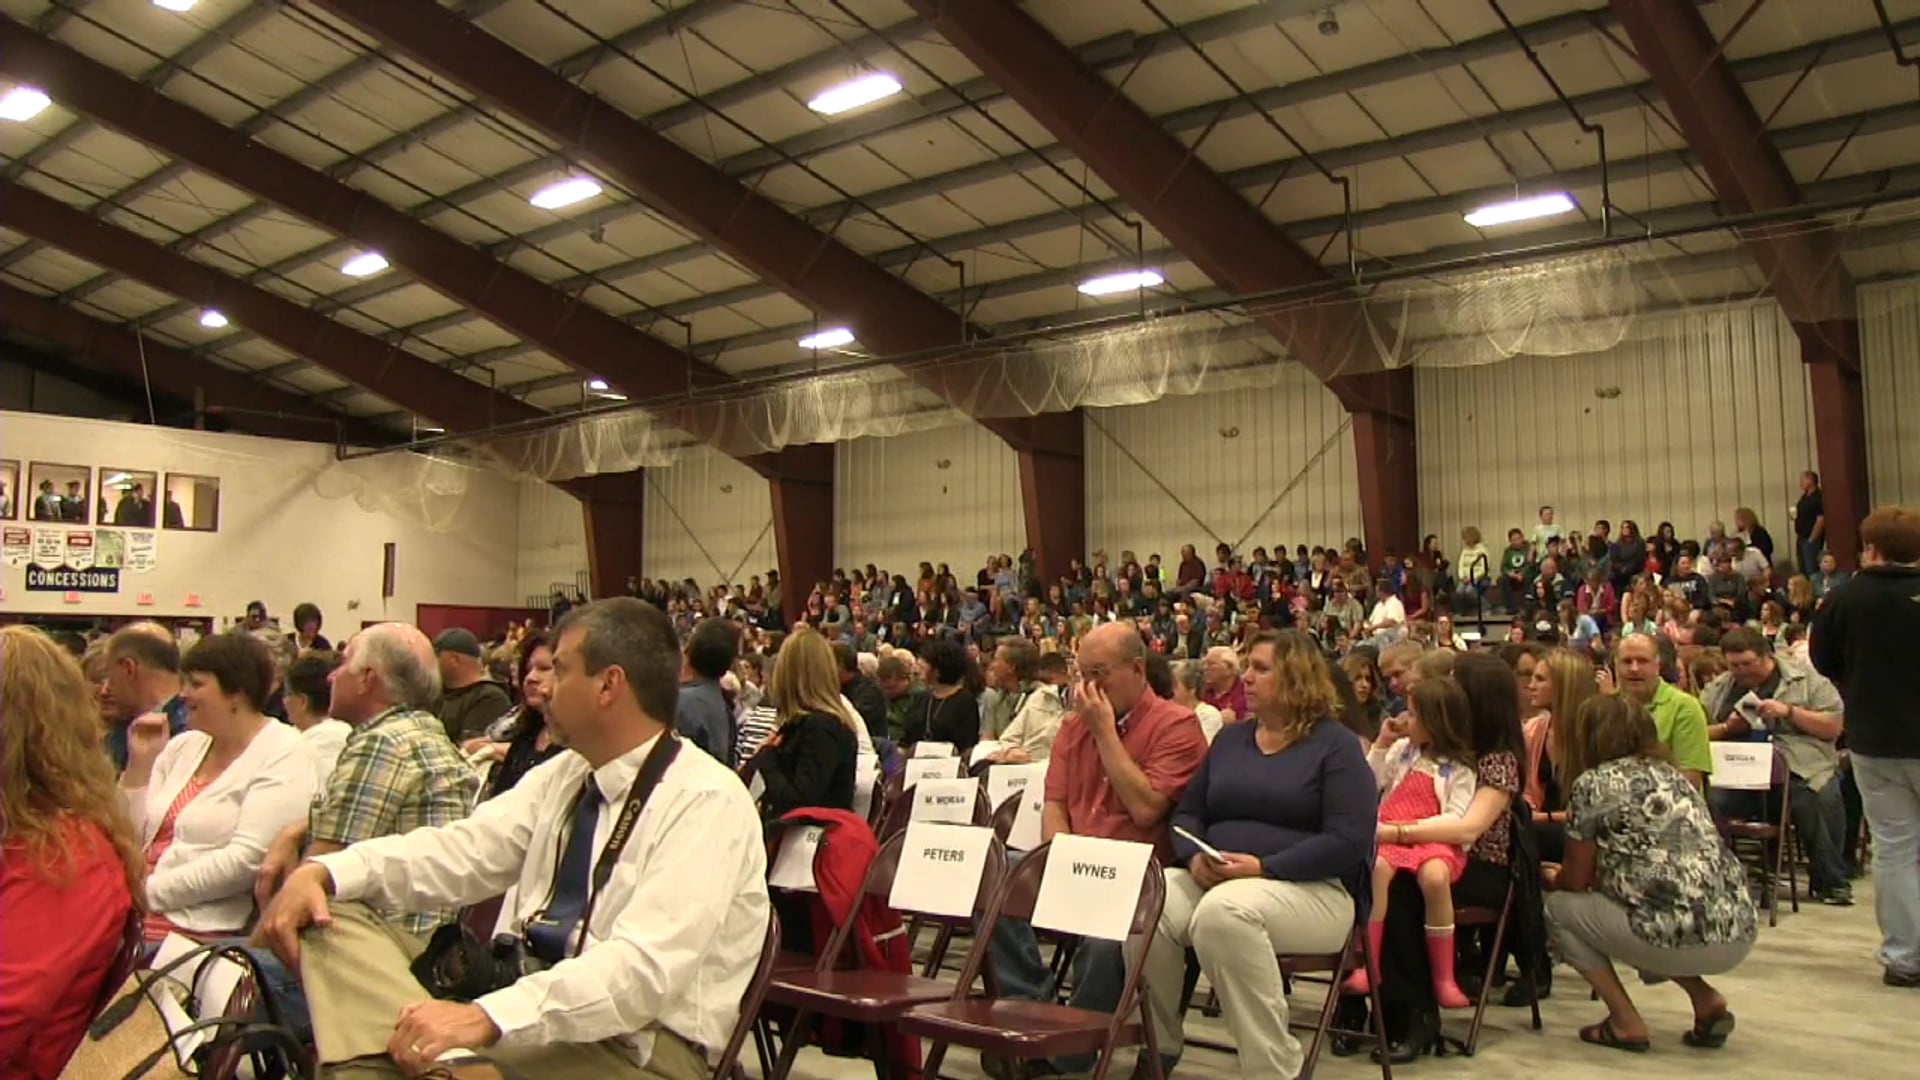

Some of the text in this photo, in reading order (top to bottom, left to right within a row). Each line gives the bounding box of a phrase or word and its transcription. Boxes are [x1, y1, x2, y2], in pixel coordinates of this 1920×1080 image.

[29, 571, 116, 588] CONCESSIONS
[608, 798, 641, 850] Canon
[922, 848, 965, 863] PETERS
[1071, 861, 1117, 880] WYNES
